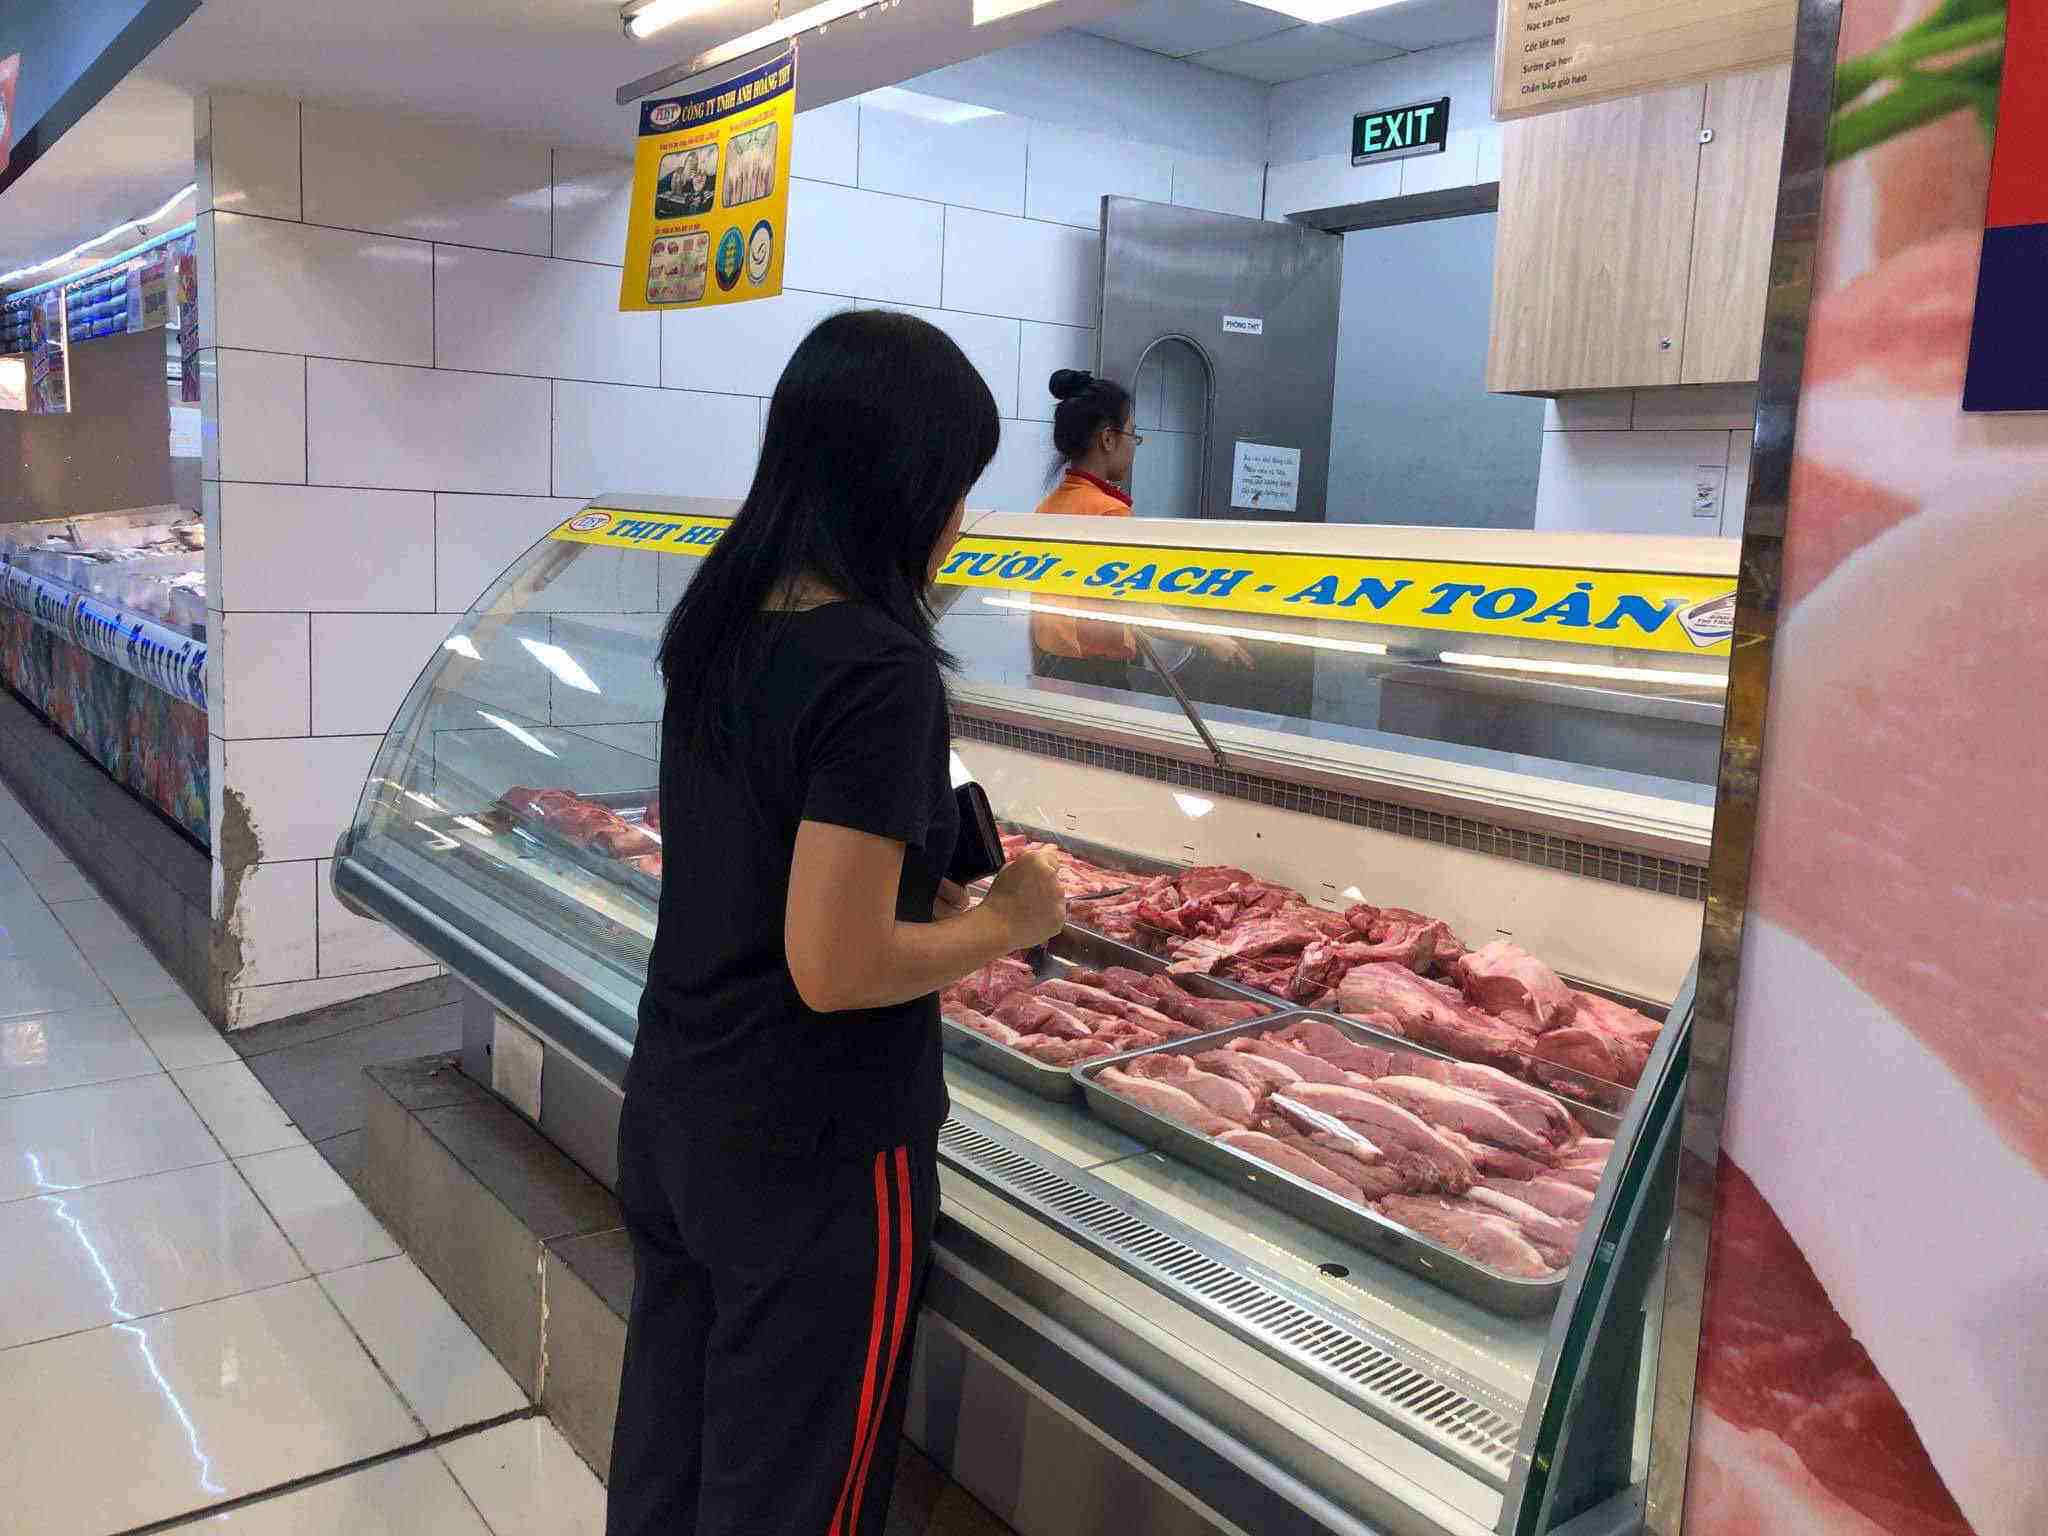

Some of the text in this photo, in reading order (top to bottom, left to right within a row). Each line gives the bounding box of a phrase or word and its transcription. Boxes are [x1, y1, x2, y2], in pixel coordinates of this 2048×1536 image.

[1555, 15, 1570, 24] heo
[1551, 37, 1566, 47] heo
[1571, 74, 1588, 84] heo
[1364, 107, 1435, 153] EXIT
[606, 519, 683, 543] THỊT
[940, 550, 1063, 582] TƯƠI
[1083, 562, 1254, 596] SẠCH
[1283, 575, 1414, 610] AN
